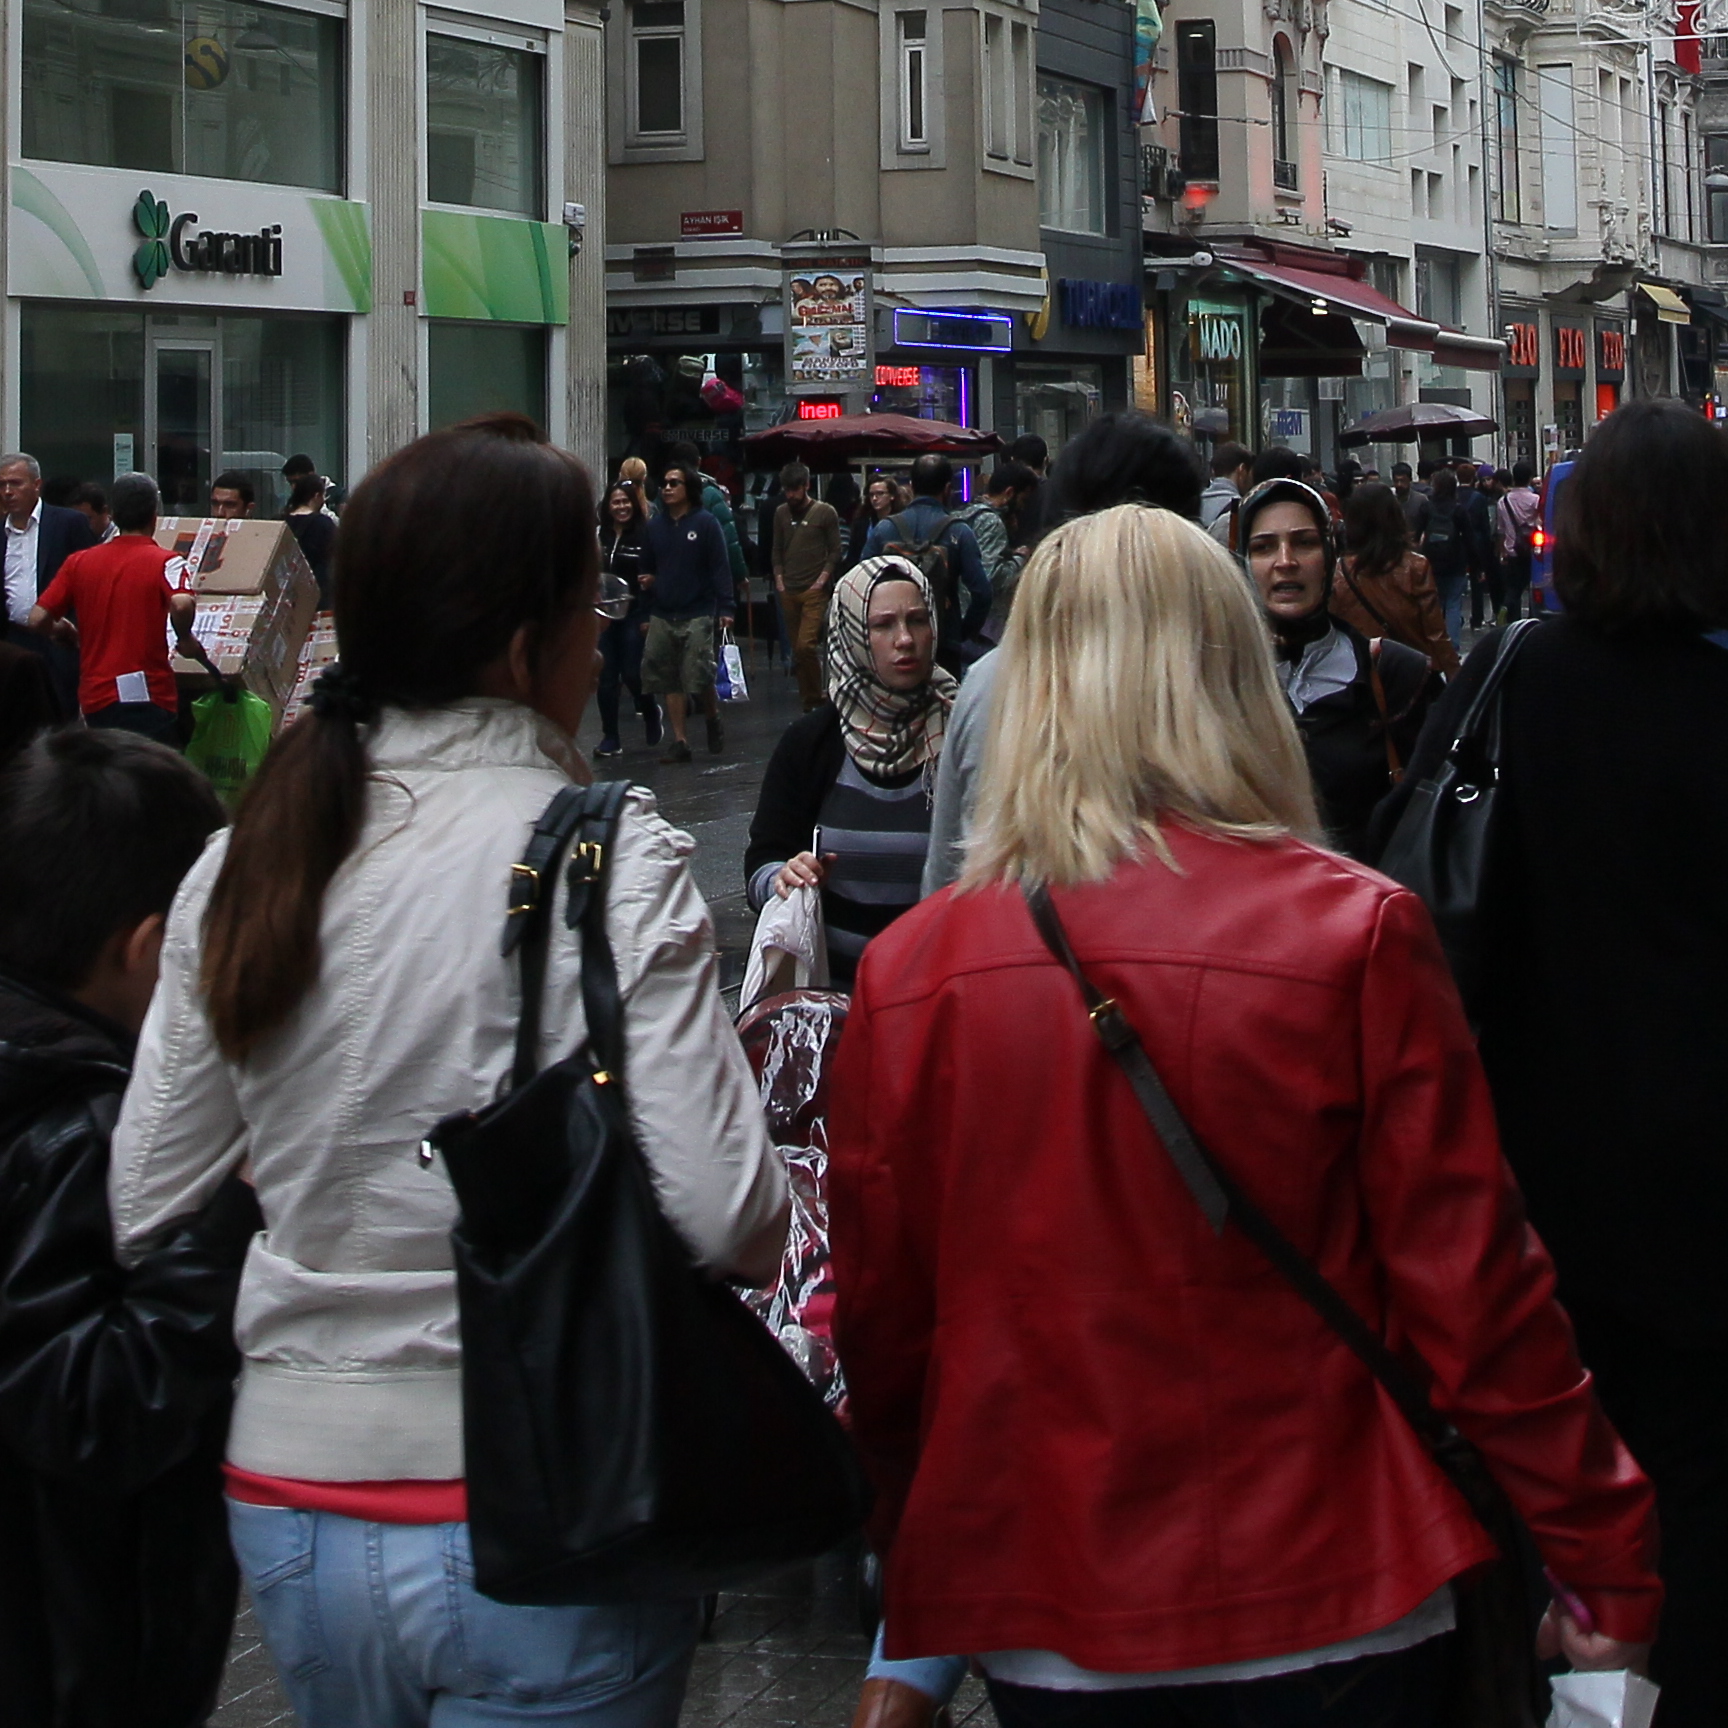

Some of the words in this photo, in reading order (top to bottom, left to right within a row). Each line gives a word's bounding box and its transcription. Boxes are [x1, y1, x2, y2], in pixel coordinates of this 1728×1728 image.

[171, 212, 283, 277] Garanti
[1200, 317, 1241, 360] MADO
[1559, 327, 1584, 368] FLO
[800, 401, 840, 420] inen
